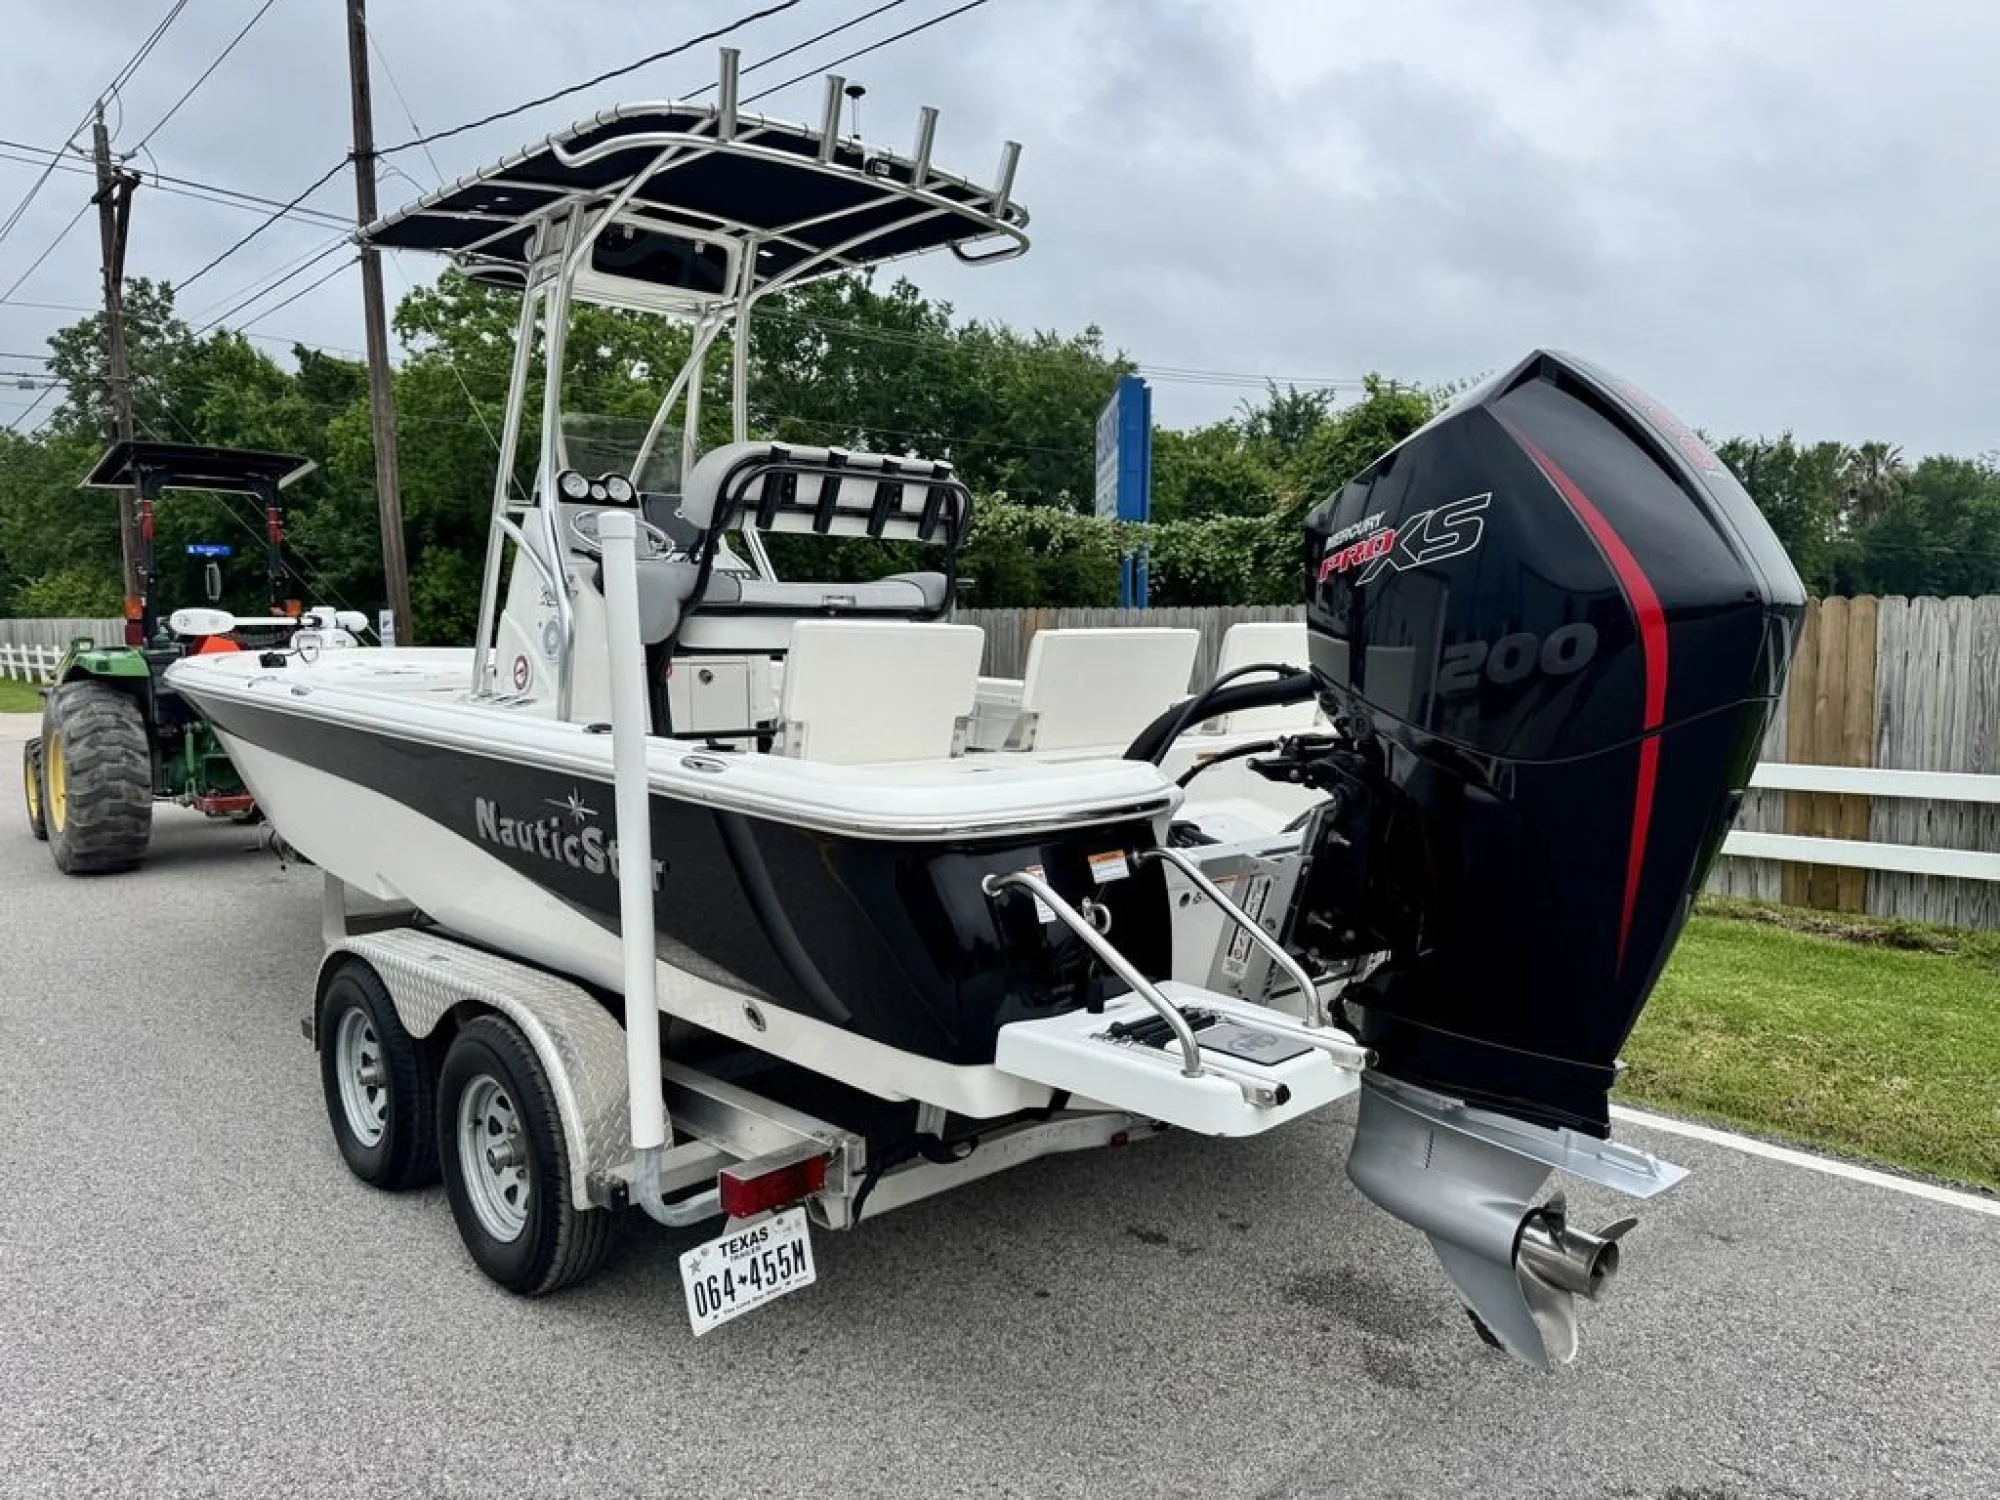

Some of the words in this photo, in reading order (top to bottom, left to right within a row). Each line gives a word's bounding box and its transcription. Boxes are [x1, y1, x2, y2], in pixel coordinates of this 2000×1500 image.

[1325, 510, 1386, 552] MERCURY
[1437, 622, 1599, 690] 200
[474, 796, 667, 892] NauticStr
[718, 1226, 769, 1258] TEXAS
